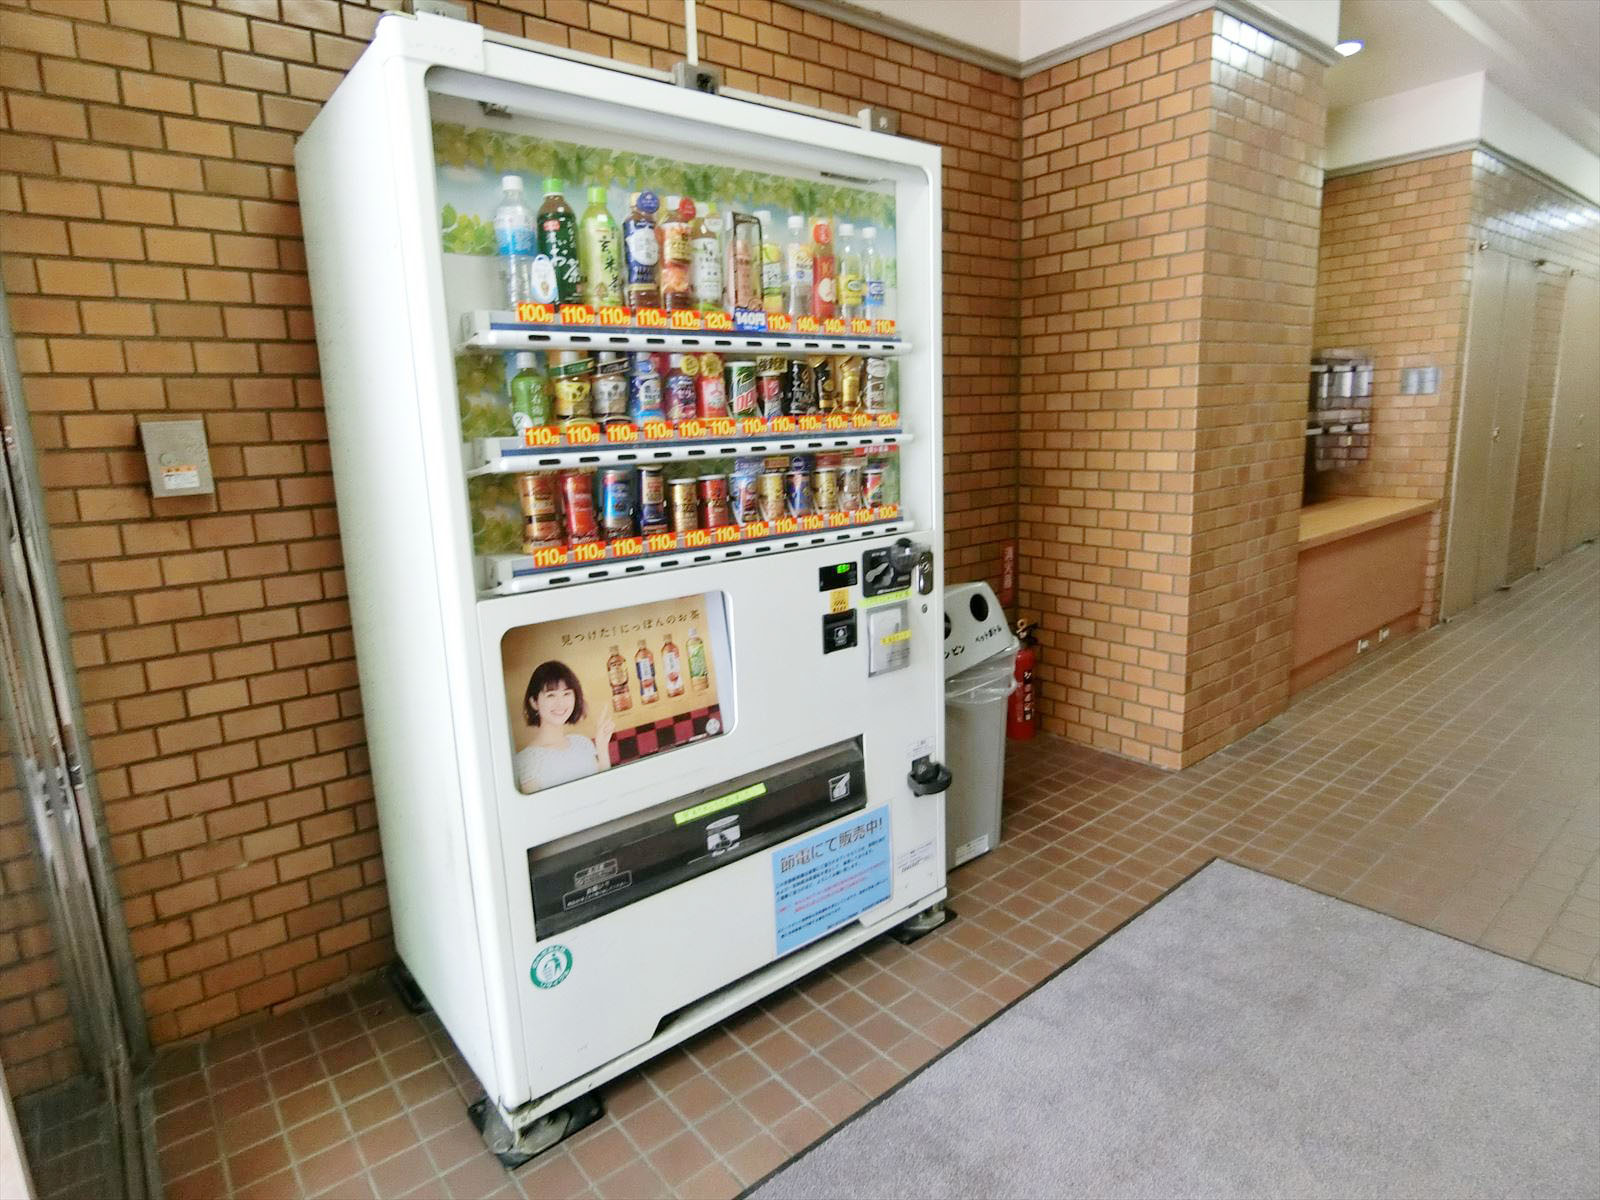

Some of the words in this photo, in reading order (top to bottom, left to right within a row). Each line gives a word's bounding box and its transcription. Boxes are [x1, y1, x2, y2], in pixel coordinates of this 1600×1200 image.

[520, 304, 553, 322] 100円
[562, 305, 594, 324] 110円
[600, 307, 631, 325] 110円
[638, 309, 667, 327] 110円
[673, 310, 701, 328] 110円
[645, 423, 673, 438] 110円
[680, 421, 707, 436] 110円
[710, 421, 736, 434] 110円
[772, 418, 795, 431] 110円
[799, 417, 822, 430] 110円
[526, 429, 560, 445] 110円
[567, 425, 599, 443] 110円
[608, 424, 637, 441] 110円
[746, 523, 769, 537] 110円
[776, 518, 798, 532] 110円
[803, 516, 824, 529] 110円
[686, 531, 711, 546] 110円
[715, 527, 740, 541] 110円
[613, 540, 642, 556] 110円
[649, 535, 677, 550] 110円
[535, 549, 567, 566] 110円
[574, 544, 606, 560] 110円
